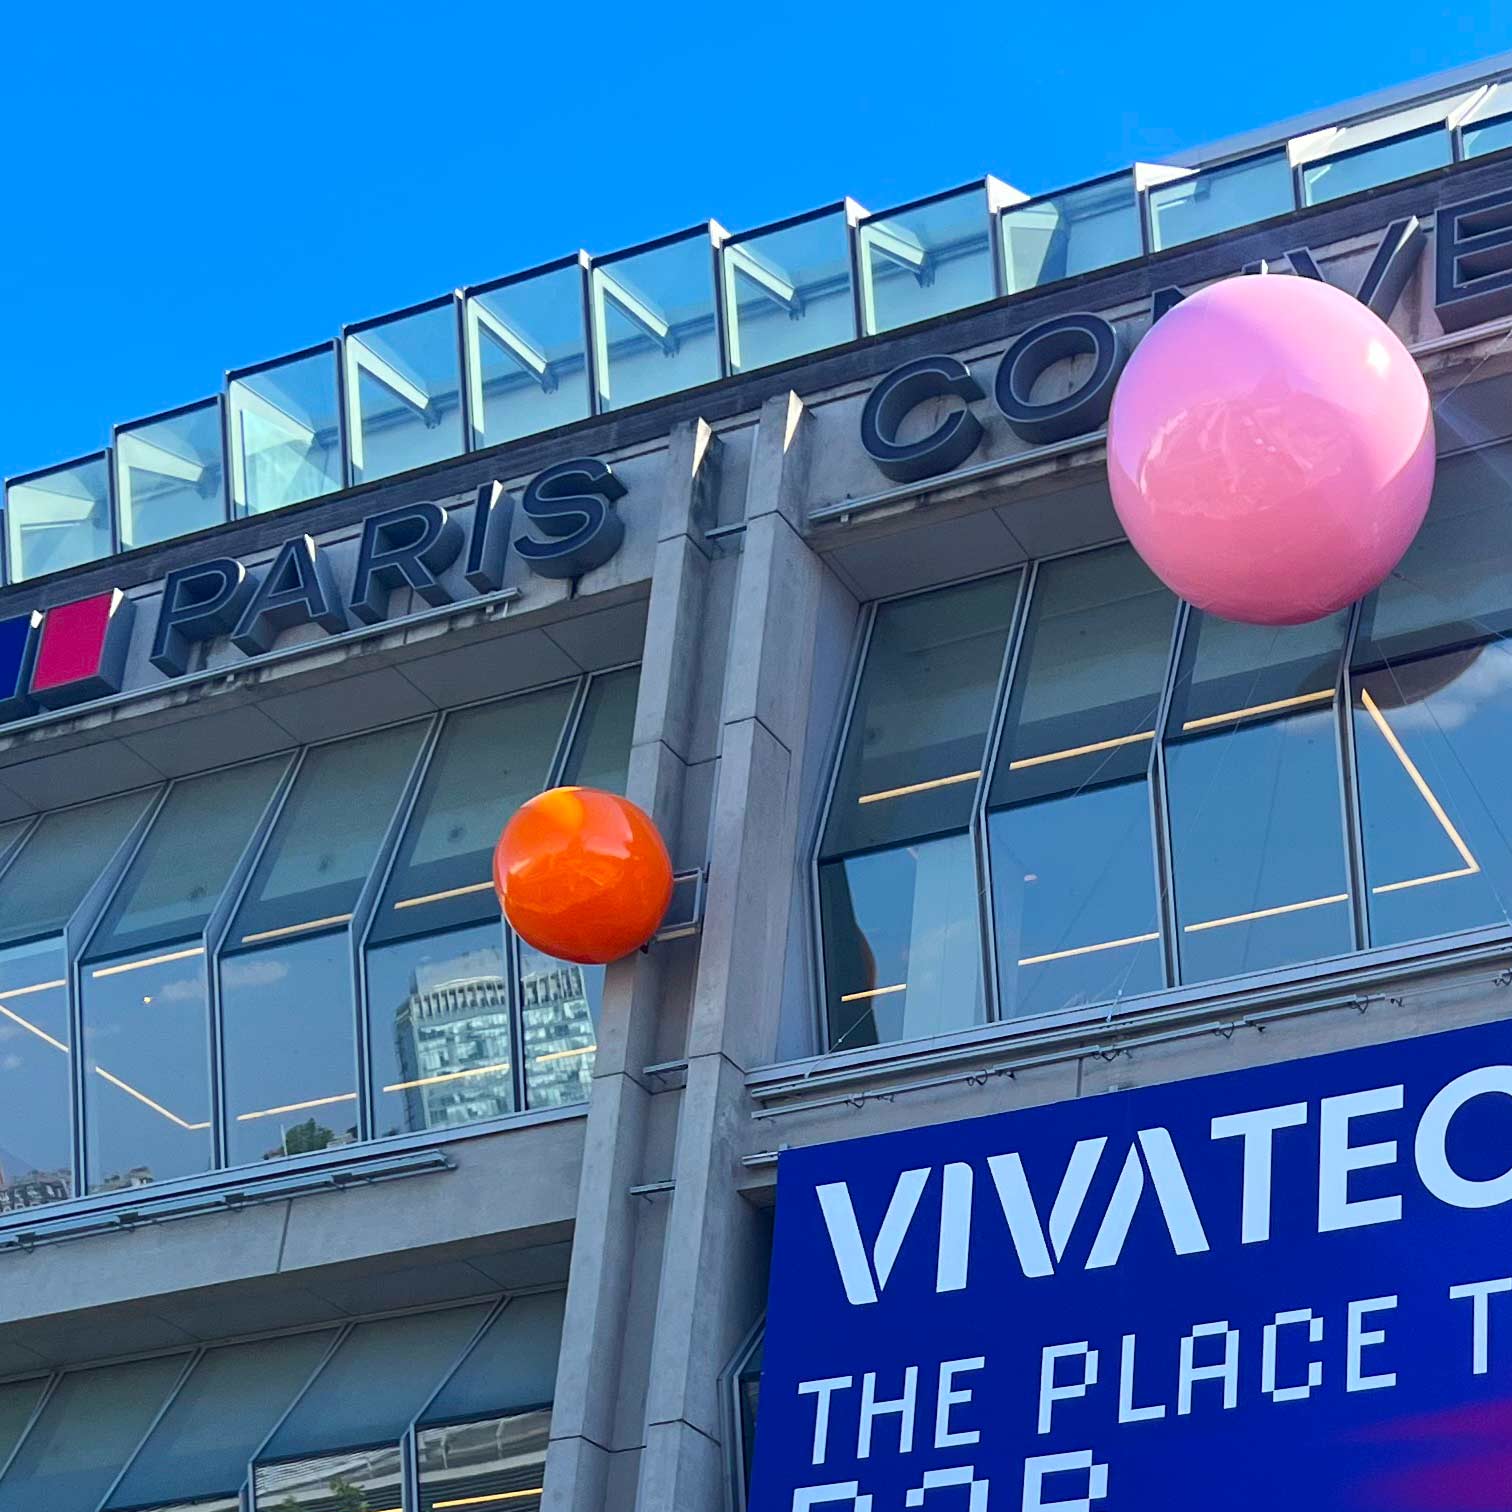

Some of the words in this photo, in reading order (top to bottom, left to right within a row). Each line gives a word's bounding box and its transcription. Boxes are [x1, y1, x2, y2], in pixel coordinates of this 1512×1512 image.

[149, 457, 626, 678] PARIS
[798, 1356, 985, 1465] THE
[1038, 1295, 1398, 1434] PLACE
